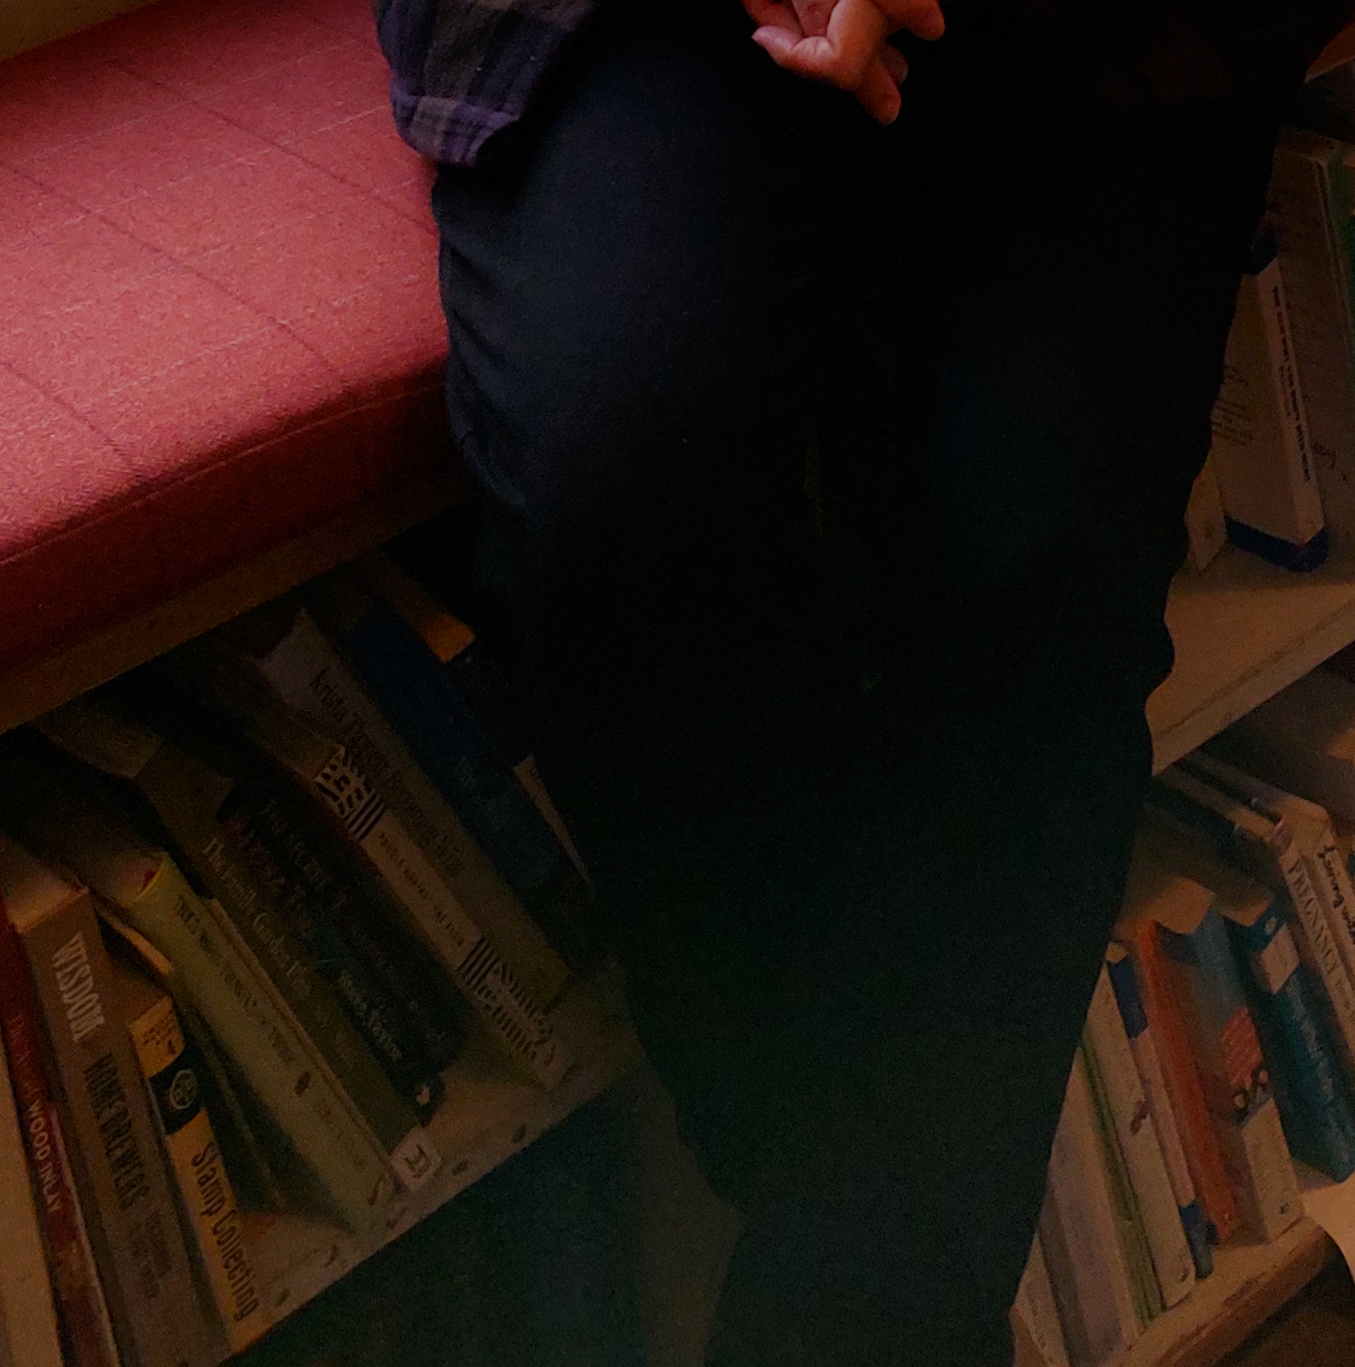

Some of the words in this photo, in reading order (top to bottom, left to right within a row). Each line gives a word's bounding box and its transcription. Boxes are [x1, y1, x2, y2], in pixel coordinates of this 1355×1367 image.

[52, 931, 105, 1042] WISDOM
[24, 1103, 52, 1163] WOOD
[38, 1161, 63, 1215] INLAY
[190, 1143, 225, 1218] Stamp
[210, 1209, 260, 1322] Collecting
